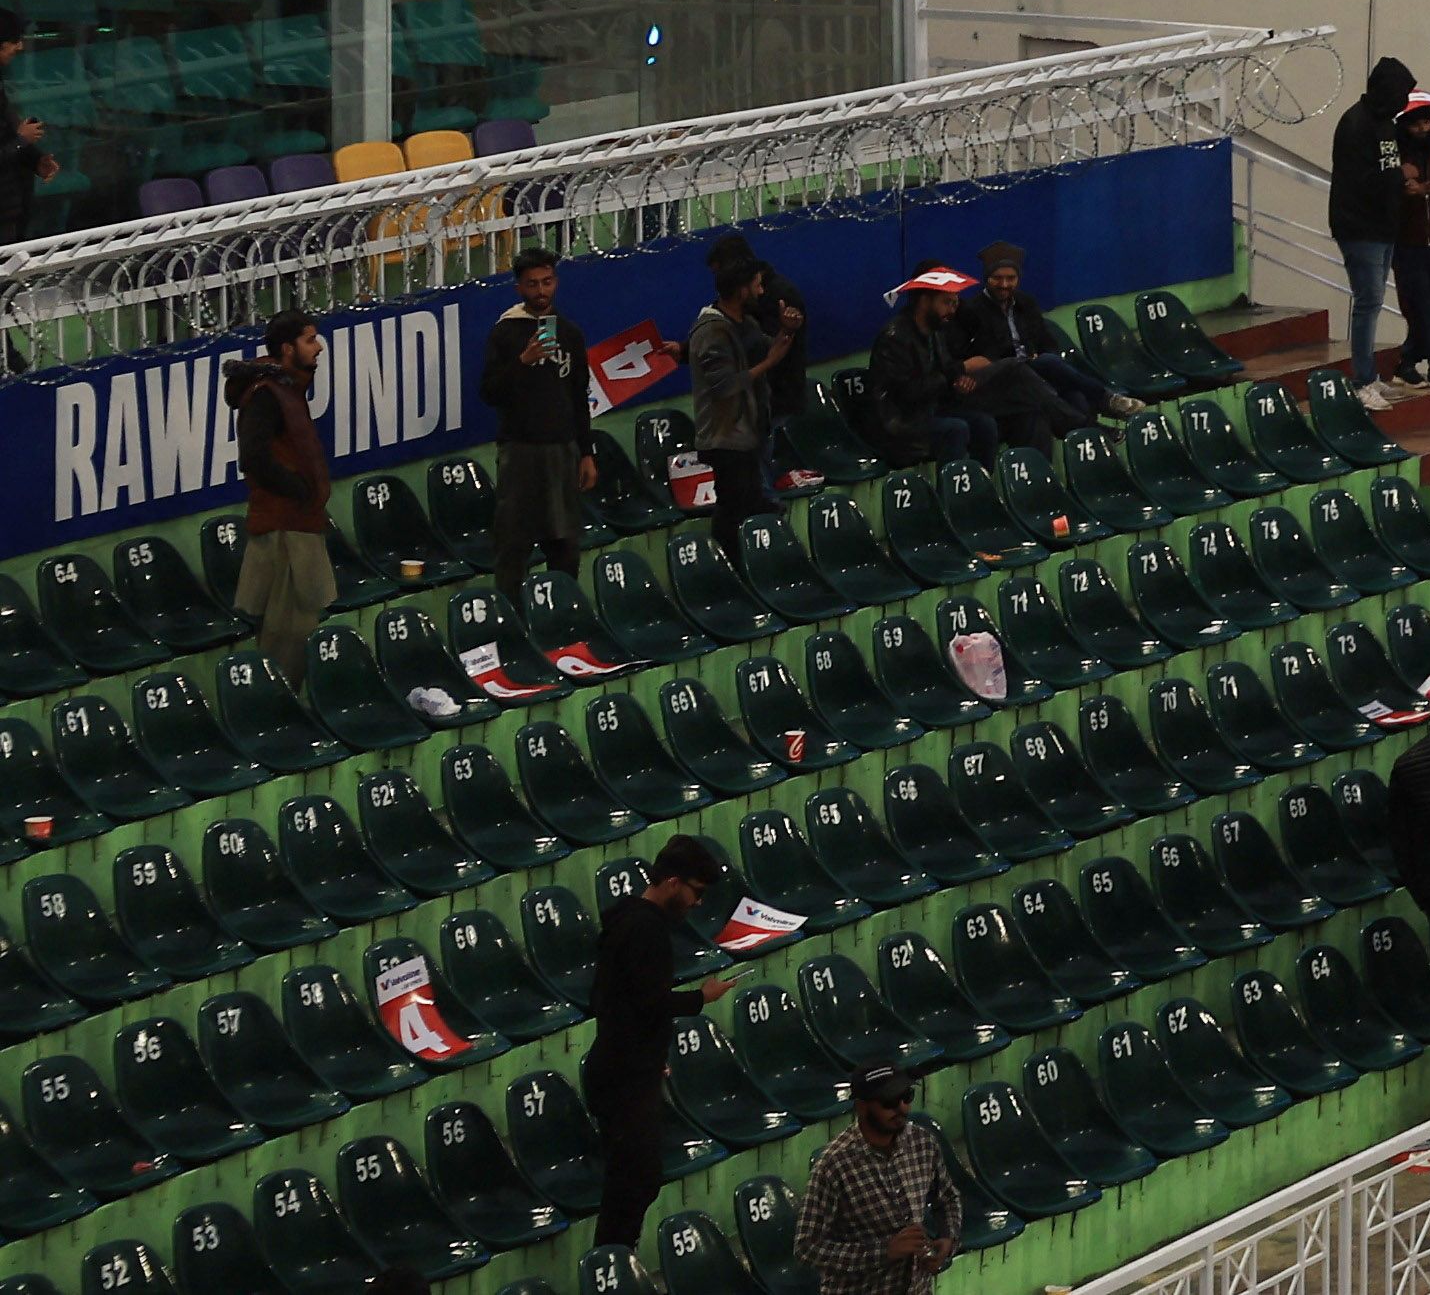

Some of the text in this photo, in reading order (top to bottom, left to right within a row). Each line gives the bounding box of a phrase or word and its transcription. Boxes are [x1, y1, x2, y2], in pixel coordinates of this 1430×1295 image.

[1148, 302, 1166, 319] 80
[1086, 315, 1103, 332] 79
[1191, 412, 1208, 430] 77
[443, 465, 464, 483] 69
[1012, 463, 1028, 480] 74
[953, 474, 970, 493] 73
[894, 490, 911, 508] 72
[1322, 499, 1339, 521] 76
[1262, 520, 1279, 539] 75
[129, 543, 153, 563] 65
[55, 563, 78, 583] 64
[389, 615, 407, 640] 65
[884, 627, 902, 648] 69
[1338, 635, 1356, 654] 73
[816, 651, 831, 670] 68
[1283, 656, 1299, 675] 72
[230, 664, 252, 684] 63
[147, 687, 169, 708] 62
[598, 709, 618, 730] 65
[1090, 710, 1108, 728] 69
[529, 737, 547, 757] 64
[455, 759, 472, 780] 63
[964, 754, 983, 775] 67
[1093, 872, 1112, 892] 65
[41, 894, 65, 918] 58
[1024, 893, 1044, 914] 64
[967, 916, 987, 936] 63
[1373, 930, 1392, 952] 65
[1312, 957, 1330, 979] 64
[813, 968, 834, 991] 61
[1244, 980, 1261, 1003] 63
[218, 1009, 241, 1033] 57
[399, 1002, 451, 1055] 4
[1169, 1006, 1187, 1030] 62
[678, 1030, 700, 1054] 59
[1113, 1031, 1131, 1058] 61
[1038, 1061, 1058, 1085] 60
[42, 1075, 69, 1102] 55
[980, 1094, 1001, 1124] 59
[443, 1120, 464, 1145] 56
[356, 1155, 380, 1181] 55
[275, 1190, 300, 1216] 54
[750, 1197, 772, 1221] 56
[193, 1225, 218, 1251] 53
[673, 1228, 700, 1255] 55
[596, 1265, 618, 1292] 54
